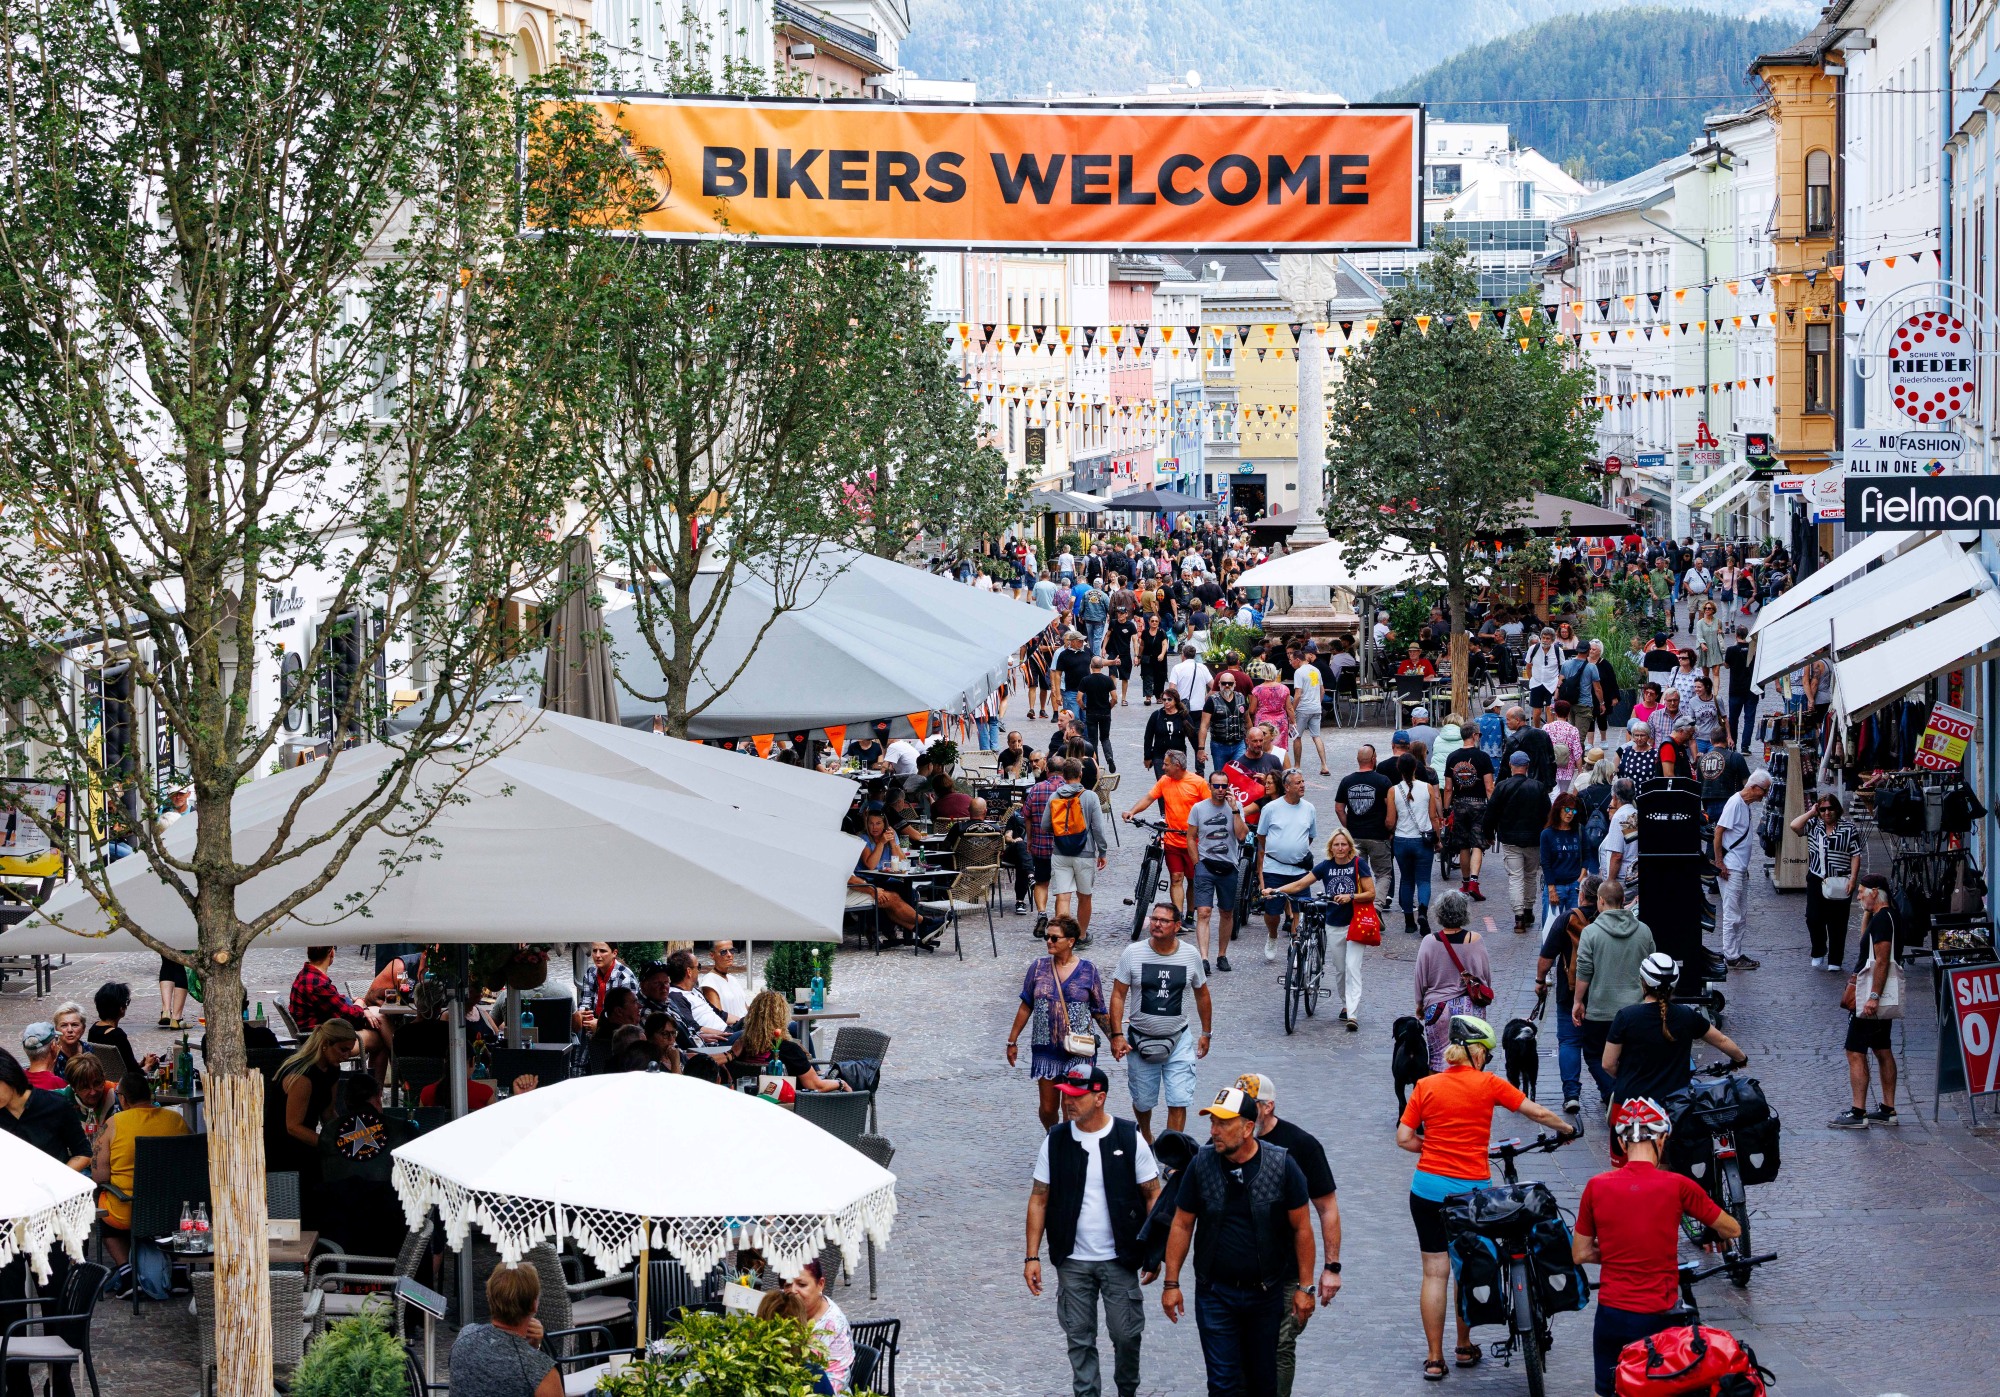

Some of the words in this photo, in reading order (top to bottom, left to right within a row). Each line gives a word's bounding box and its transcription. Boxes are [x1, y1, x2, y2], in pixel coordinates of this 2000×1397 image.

[702, 146, 966, 203] BIKERS
[990, 153, 1369, 206] WELCOME
[1893, 359, 1971, 372] RIEDER
[1880, 435, 1900, 448] NO
[1900, 439, 1960, 451] FASHION
[1850, 460, 1870, 472] ALL
[1876, 460, 1888, 473] IN
[1894, 461, 1917, 473] ONE
[1928, 714, 1971, 738] FOTO
[1914, 750, 1957, 770] FOTO
[1328, 866, 1355, 876] A&FITCH
[1157, 970, 1170, 979] JCK
[1161, 979, 1167, 989] &
[1956, 971, 2000, 1006] SAL
[1156, 989, 1169, 998] JNS
